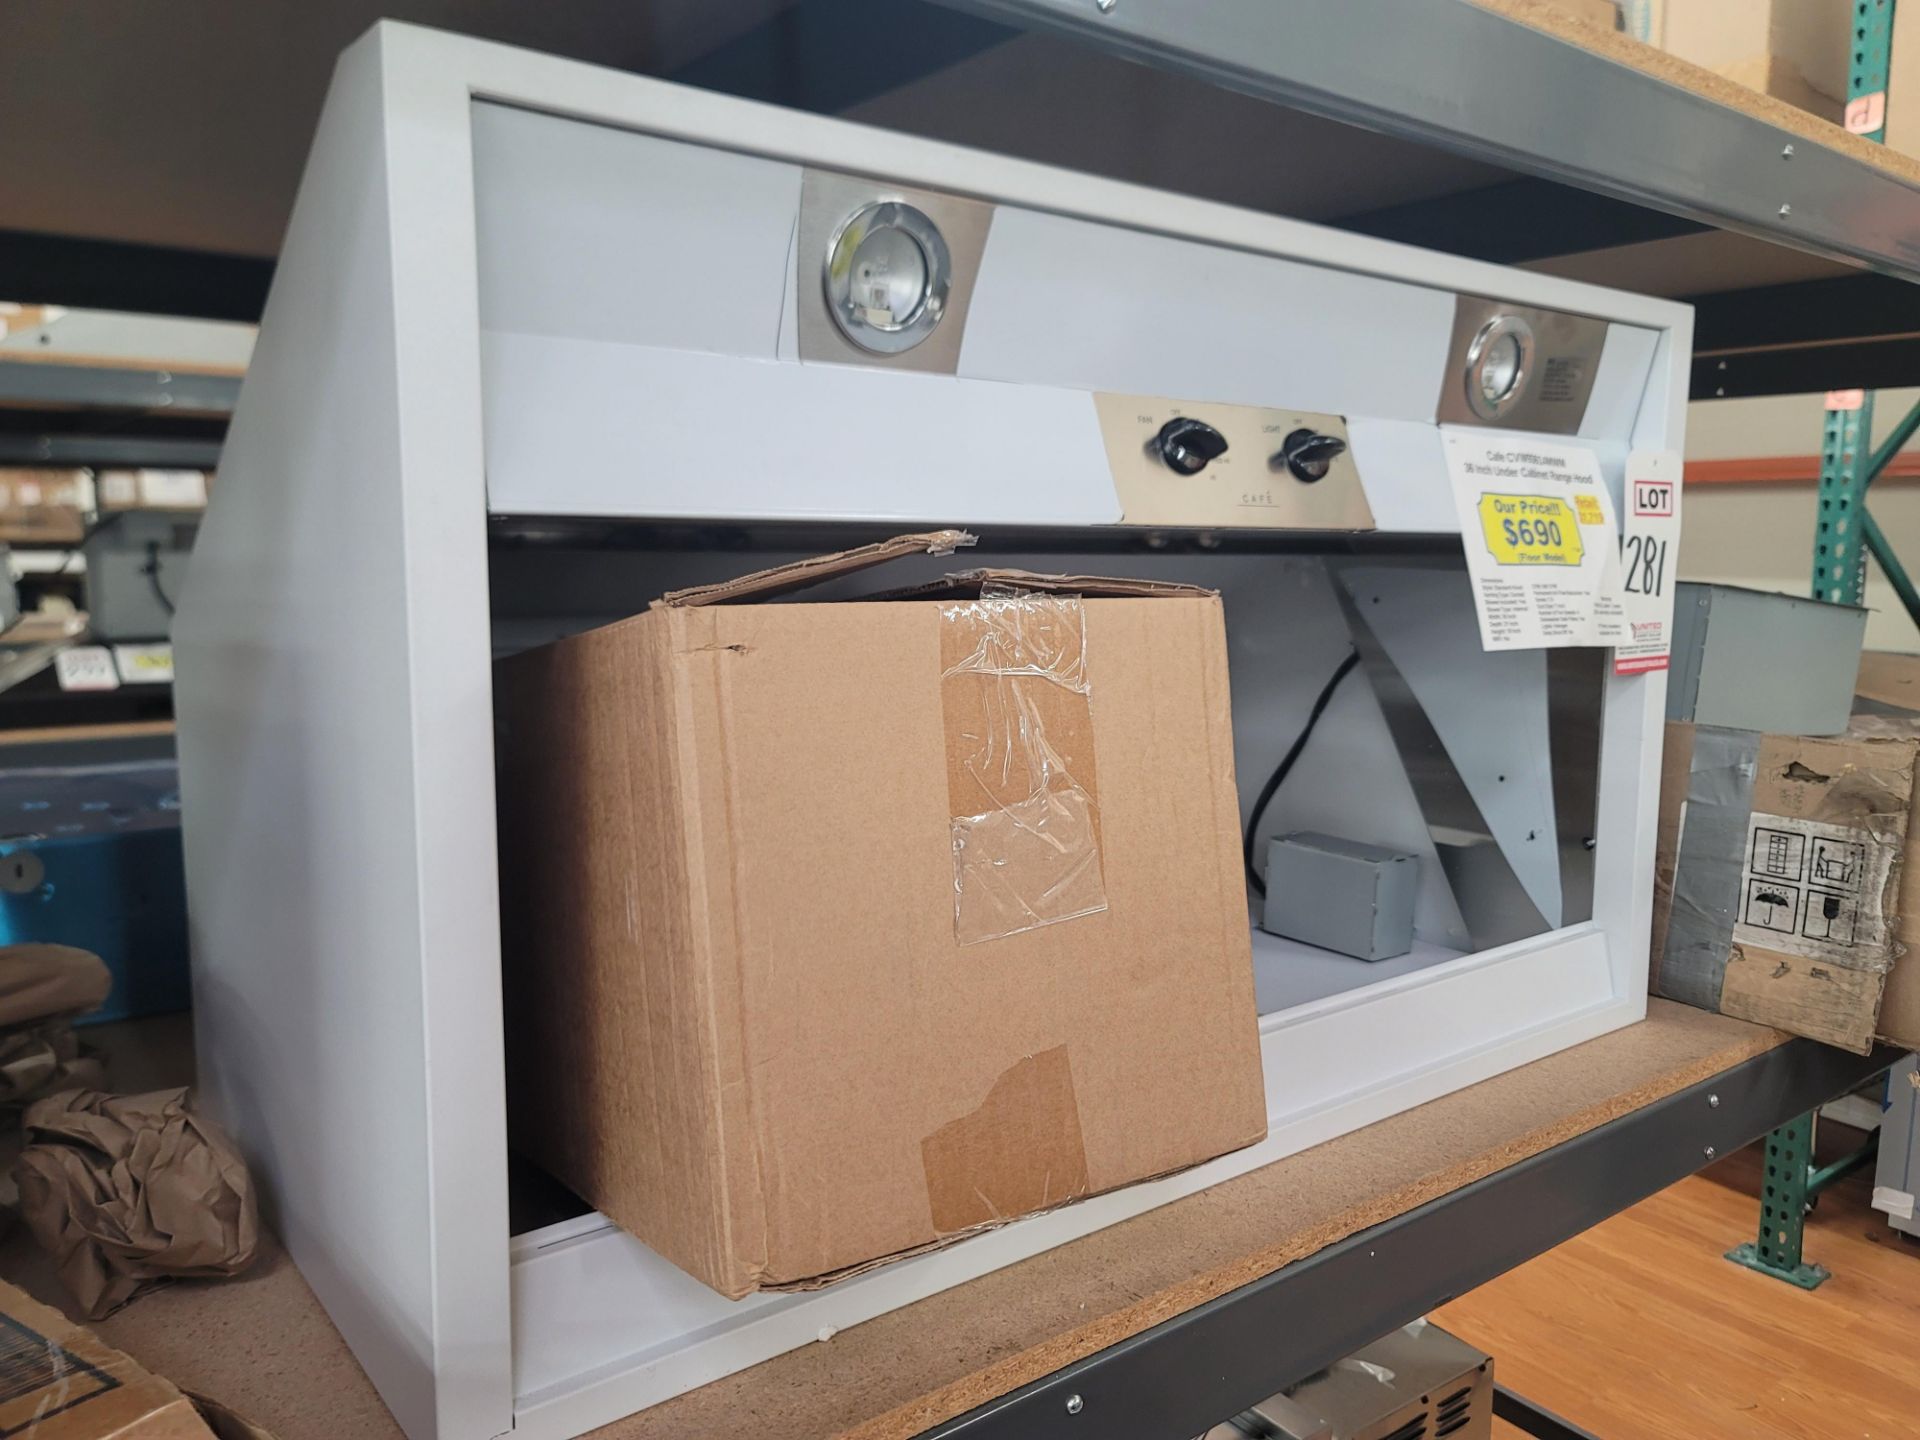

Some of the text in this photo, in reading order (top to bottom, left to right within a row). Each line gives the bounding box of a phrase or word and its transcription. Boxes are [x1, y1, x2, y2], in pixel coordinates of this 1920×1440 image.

[1494, 499, 1516, 513] Our
[1638, 488, 1669, 509] LOT
[1503, 518, 1562, 549] $690
[1624, 535, 1667, 597] 281
